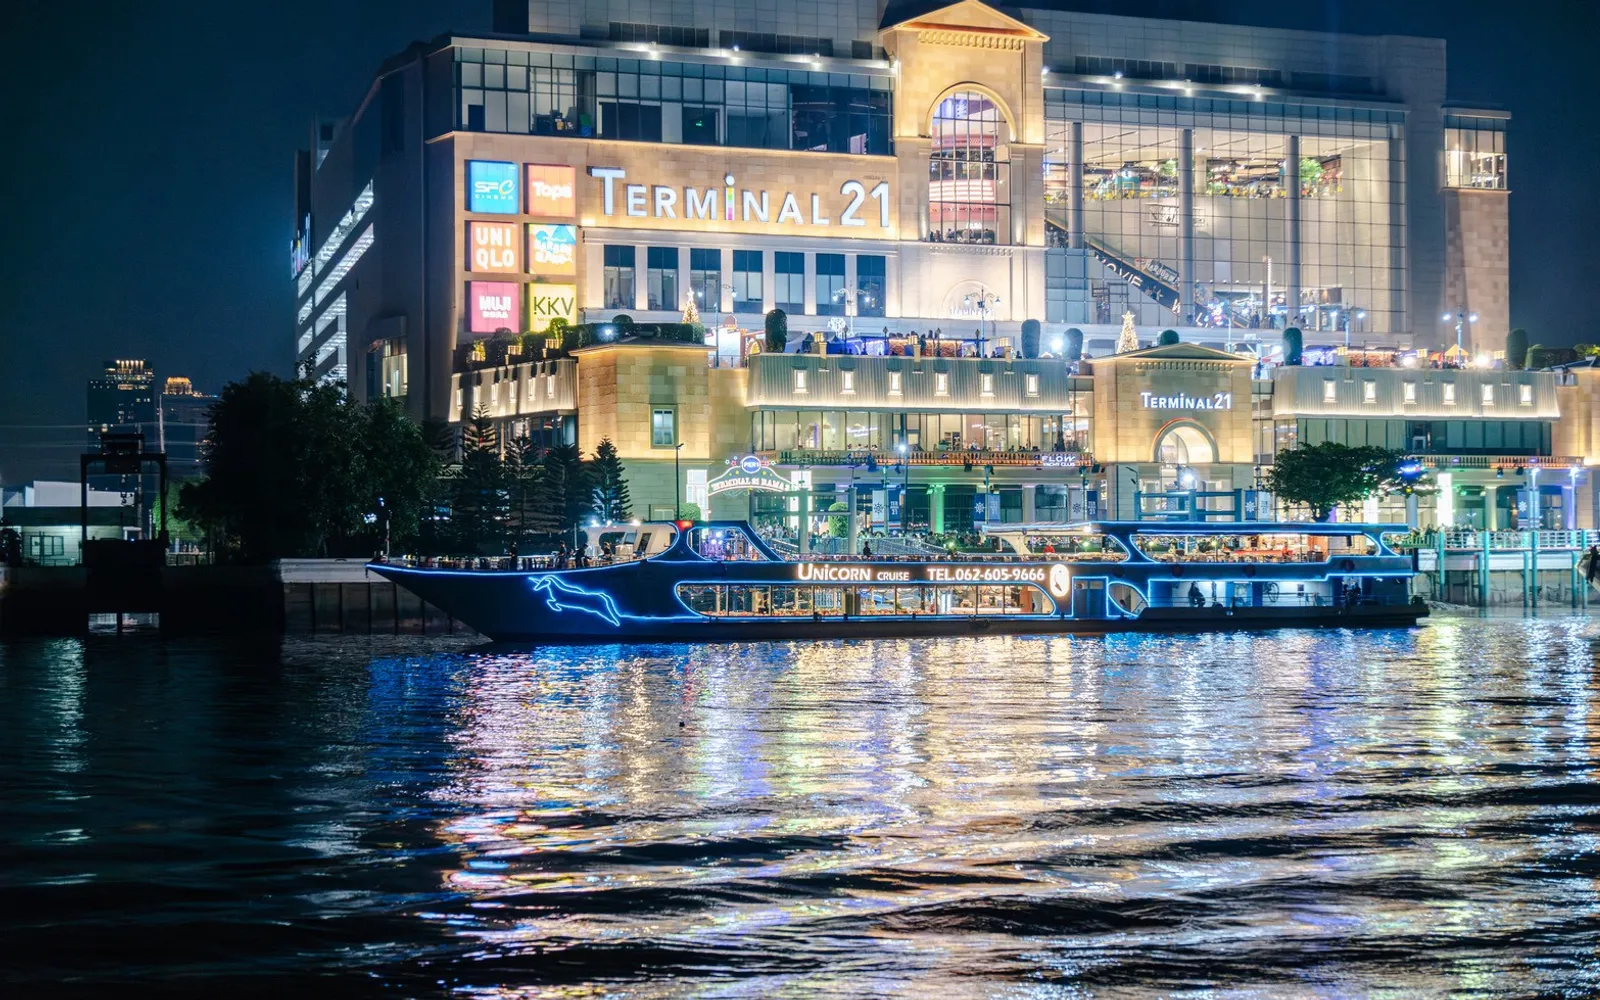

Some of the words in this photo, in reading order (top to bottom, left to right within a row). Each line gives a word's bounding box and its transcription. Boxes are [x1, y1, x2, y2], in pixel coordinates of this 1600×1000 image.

[532, 180, 572, 201] Tops
[840, 180, 890, 228] 21
[476, 227, 512, 247] UNI
[476, 247, 515, 270] QLO
[479, 295, 512, 311] MUJI
[876, 571, 910, 581] CRUISE
